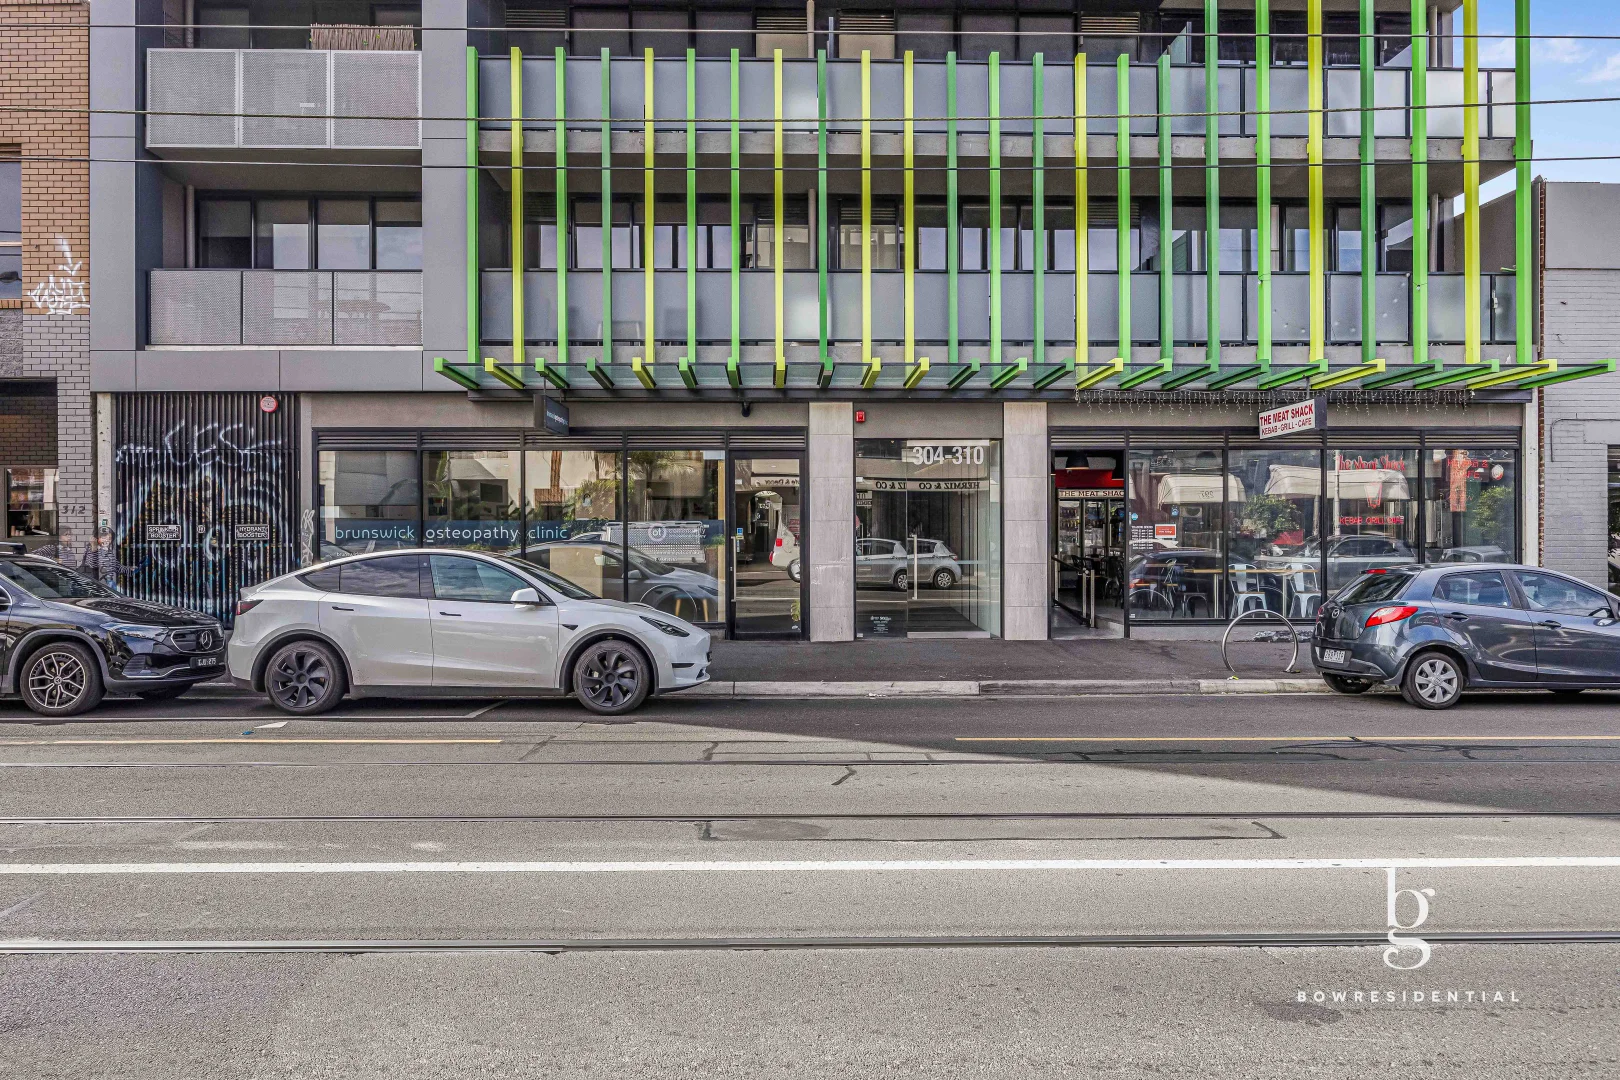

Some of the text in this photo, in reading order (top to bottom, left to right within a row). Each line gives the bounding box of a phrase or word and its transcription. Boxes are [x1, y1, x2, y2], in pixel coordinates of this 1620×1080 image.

[1260, 404, 1313, 426] THE MEAT SHACK
[912, 446, 984, 466] 304-310
[60, 505, 86, 515] 312
[335, 525, 569, 542] brunswick osteopathy clinic
